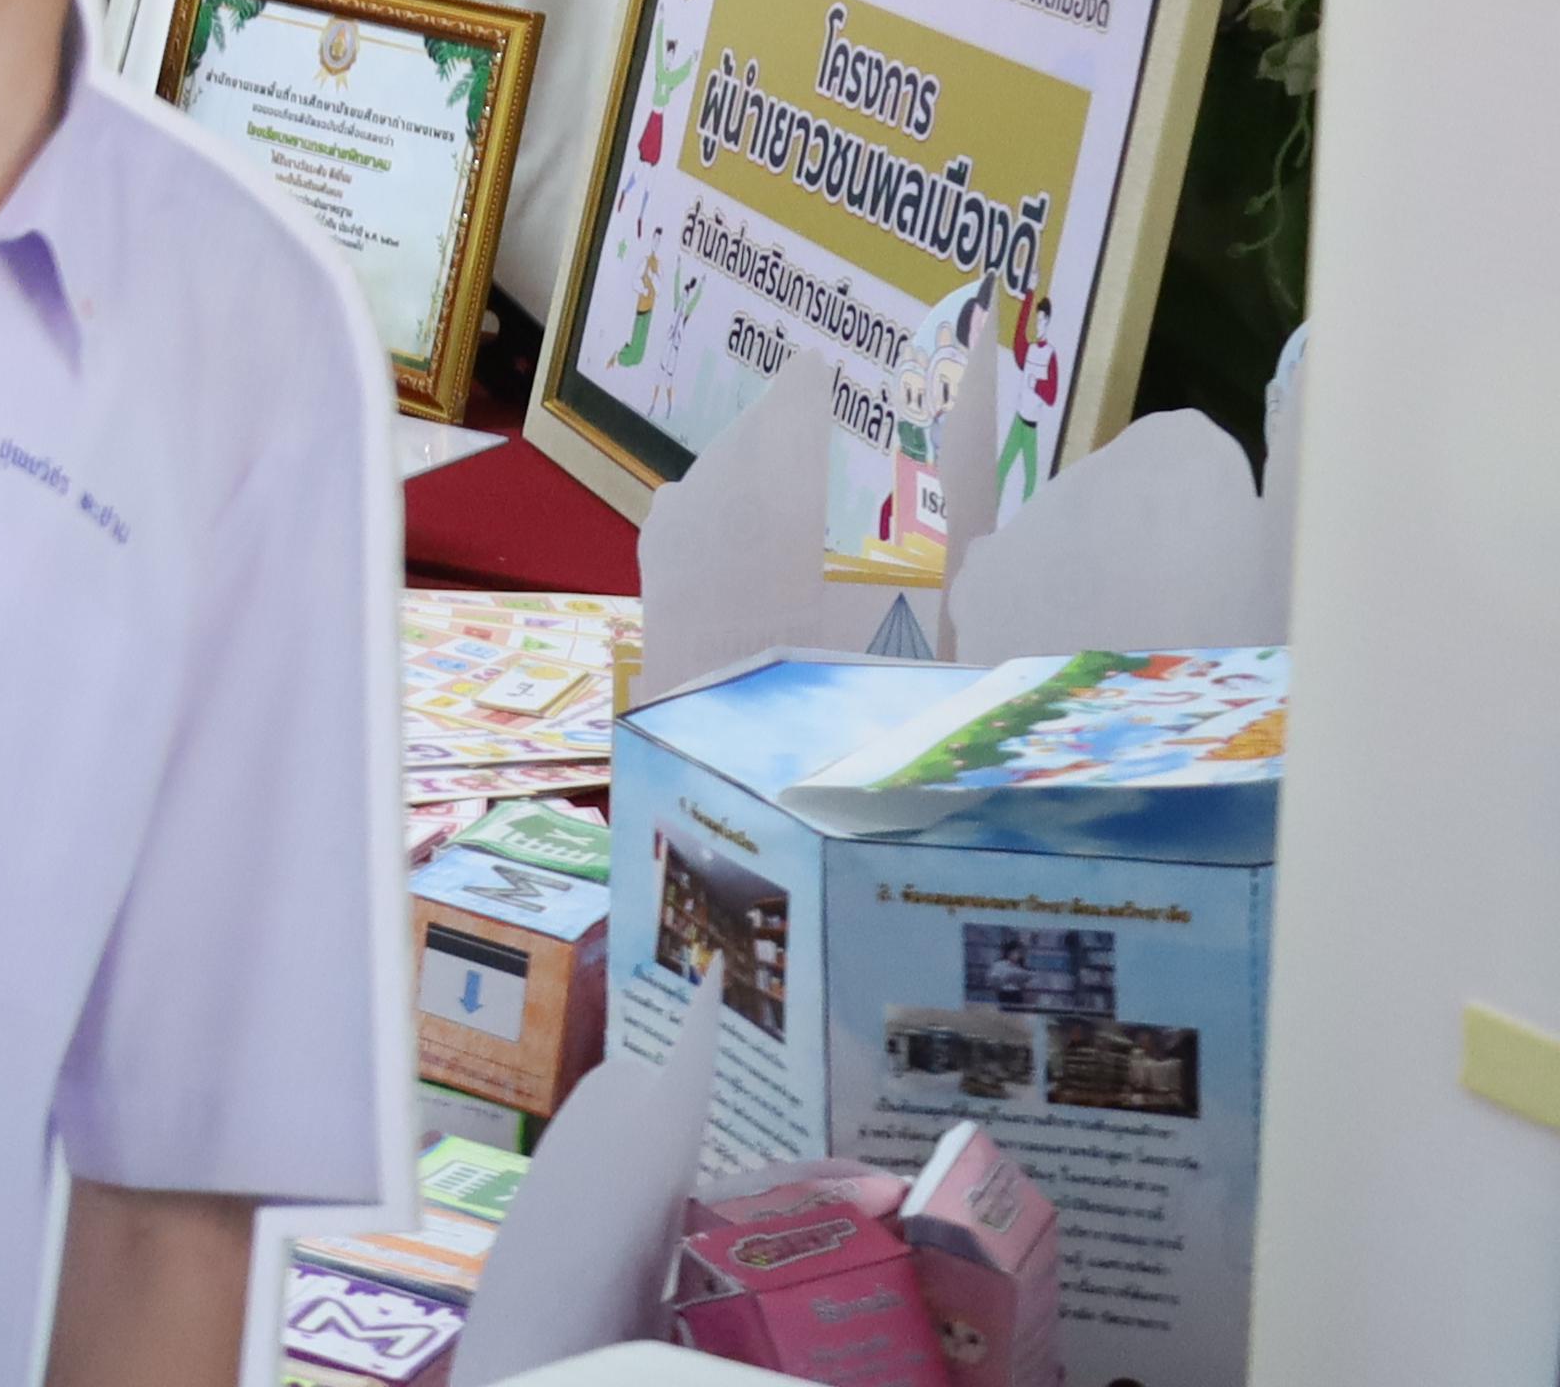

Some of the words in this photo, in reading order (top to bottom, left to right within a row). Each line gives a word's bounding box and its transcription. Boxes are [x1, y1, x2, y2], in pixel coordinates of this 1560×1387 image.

[817, 7, 938, 138] โครงการ
[698, 52, 1049, 294] ผู้นำเยาวชนพลเมืองดี
[728, 315, 797, 375] สถาบั
